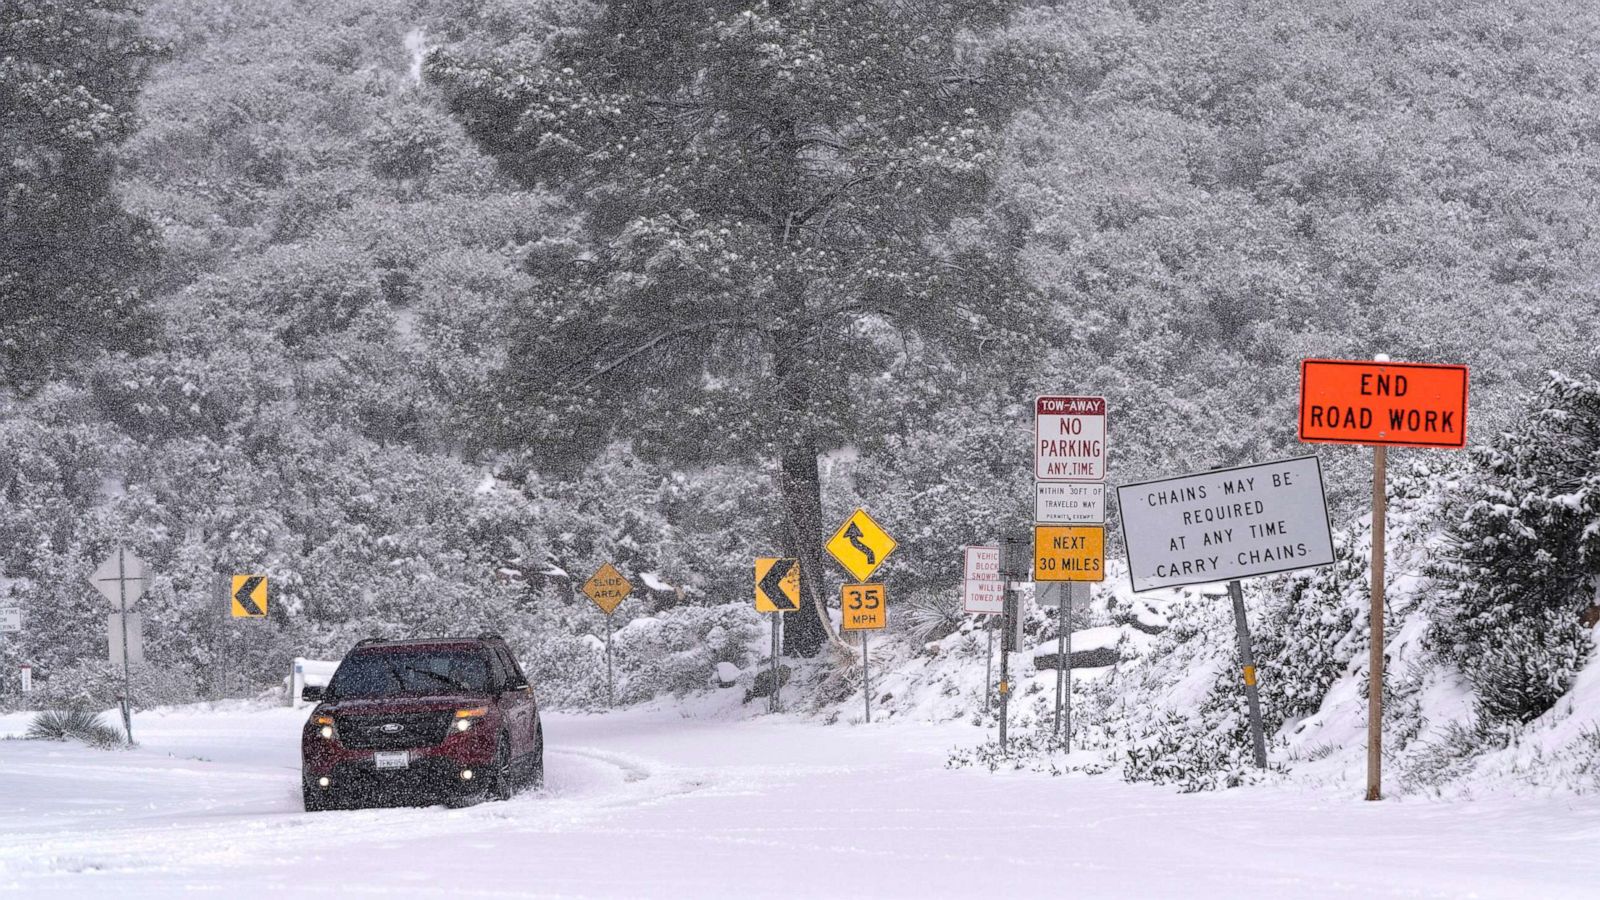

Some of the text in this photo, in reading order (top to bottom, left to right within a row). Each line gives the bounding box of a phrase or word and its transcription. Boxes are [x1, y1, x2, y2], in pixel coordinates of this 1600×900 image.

[1361, 373, 1408, 397] END
[1042, 400, 1101, 411] TOW-AWAY
[1311, 405, 1455, 433] ROAD WORK
[1060, 417, 1082, 435] NO
[1041, 439, 1100, 457] PARKING
[1047, 462, 1094, 475] ANY TIME
[1039, 487, 1102, 496] WITHIN 30FT OF
[1148, 471, 1293, 507] CHAINS MAY BE
[1045, 500, 1096, 509] TRAVELED WAY
[1183, 500, 1264, 526] REQUIRED
[1169, 520, 1287, 552] AT ANY TIME
[1053, 536, 1086, 550] NEXT
[976, 552, 998, 560] VEHIC
[1156, 543, 1307, 578] CARRY CHAINS
[975, 562, 999, 570] BLOCK
[1039, 557, 1100, 571] 30 MILES
[594, 578, 622, 587] SLIDE
[971, 572, 998, 580] SNOWPL
[594, 590, 621, 598] AREA
[978, 584, 994, 592] WILL
[849, 590, 879, 610] 35
[970, 593, 994, 602] TOWED
[852, 614, 876, 624] MPH
